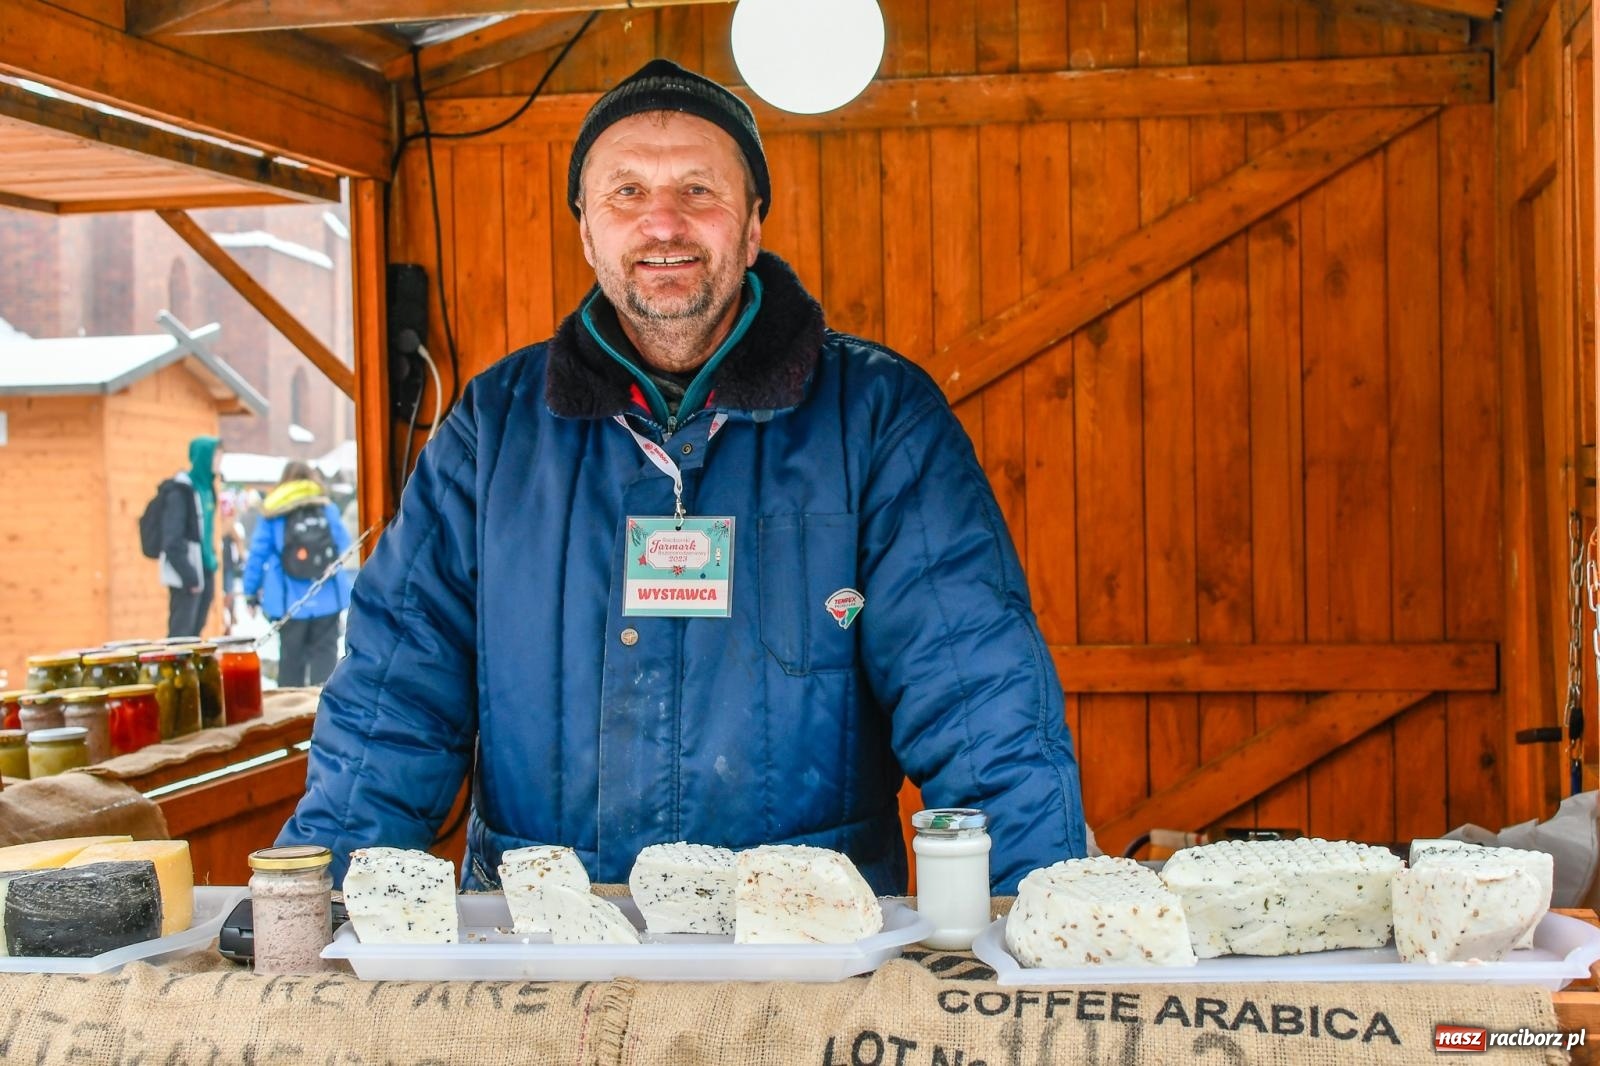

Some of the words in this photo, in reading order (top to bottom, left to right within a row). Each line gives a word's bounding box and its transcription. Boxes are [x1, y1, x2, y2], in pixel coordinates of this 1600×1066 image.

[650, 540, 696, 554] Jarmark
[637, 588, 717, 600] WYSTAWCA
[938, 989, 1140, 1023] COFFEE
[1154, 995, 1402, 1045] ARABICA
[822, 1030, 917, 1066] LOT
